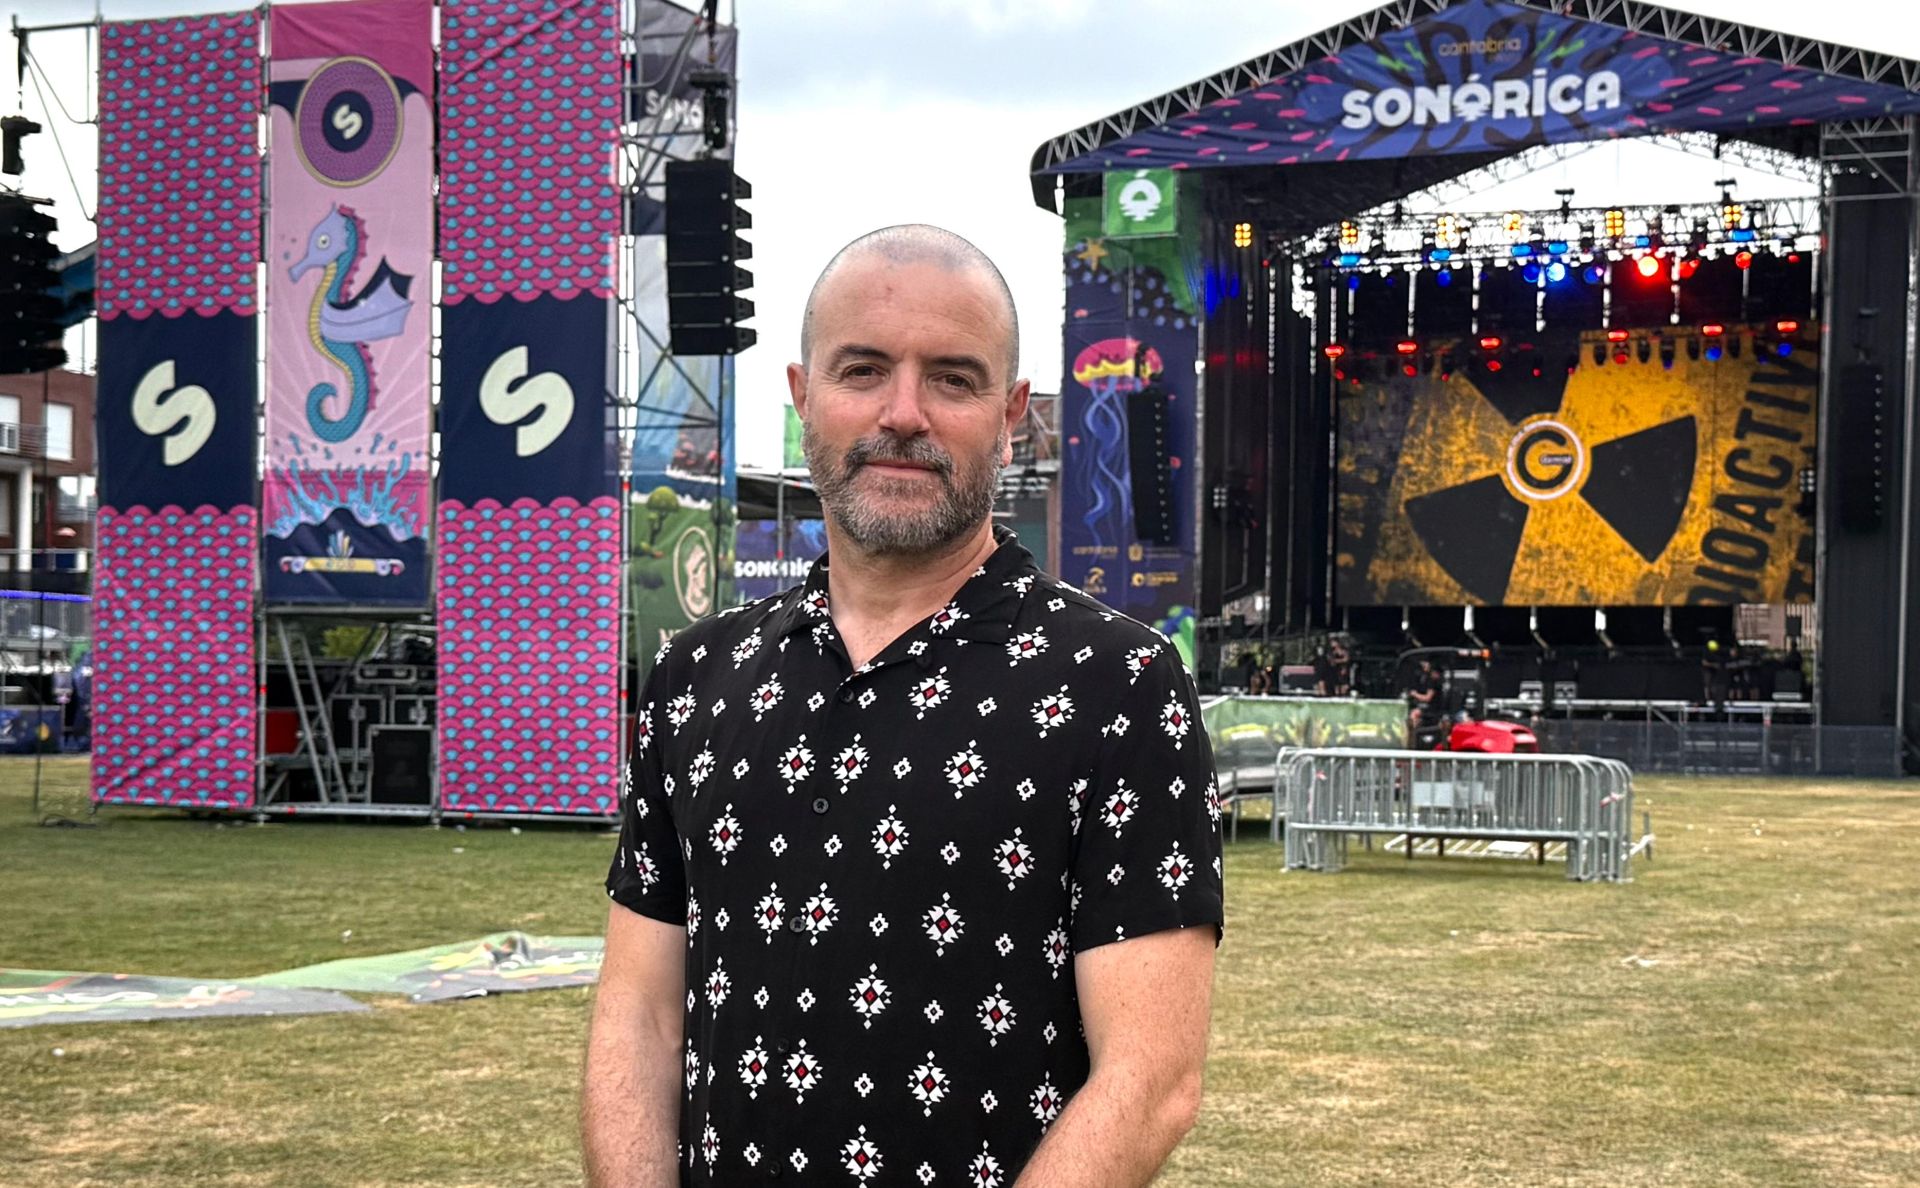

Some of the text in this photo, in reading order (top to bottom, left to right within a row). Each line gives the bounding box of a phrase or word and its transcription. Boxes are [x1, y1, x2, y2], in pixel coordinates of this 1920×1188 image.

[132, 359, 216, 466] S
[480, 345, 575, 458] S
[734, 556, 814, 578] SONÓRIC
